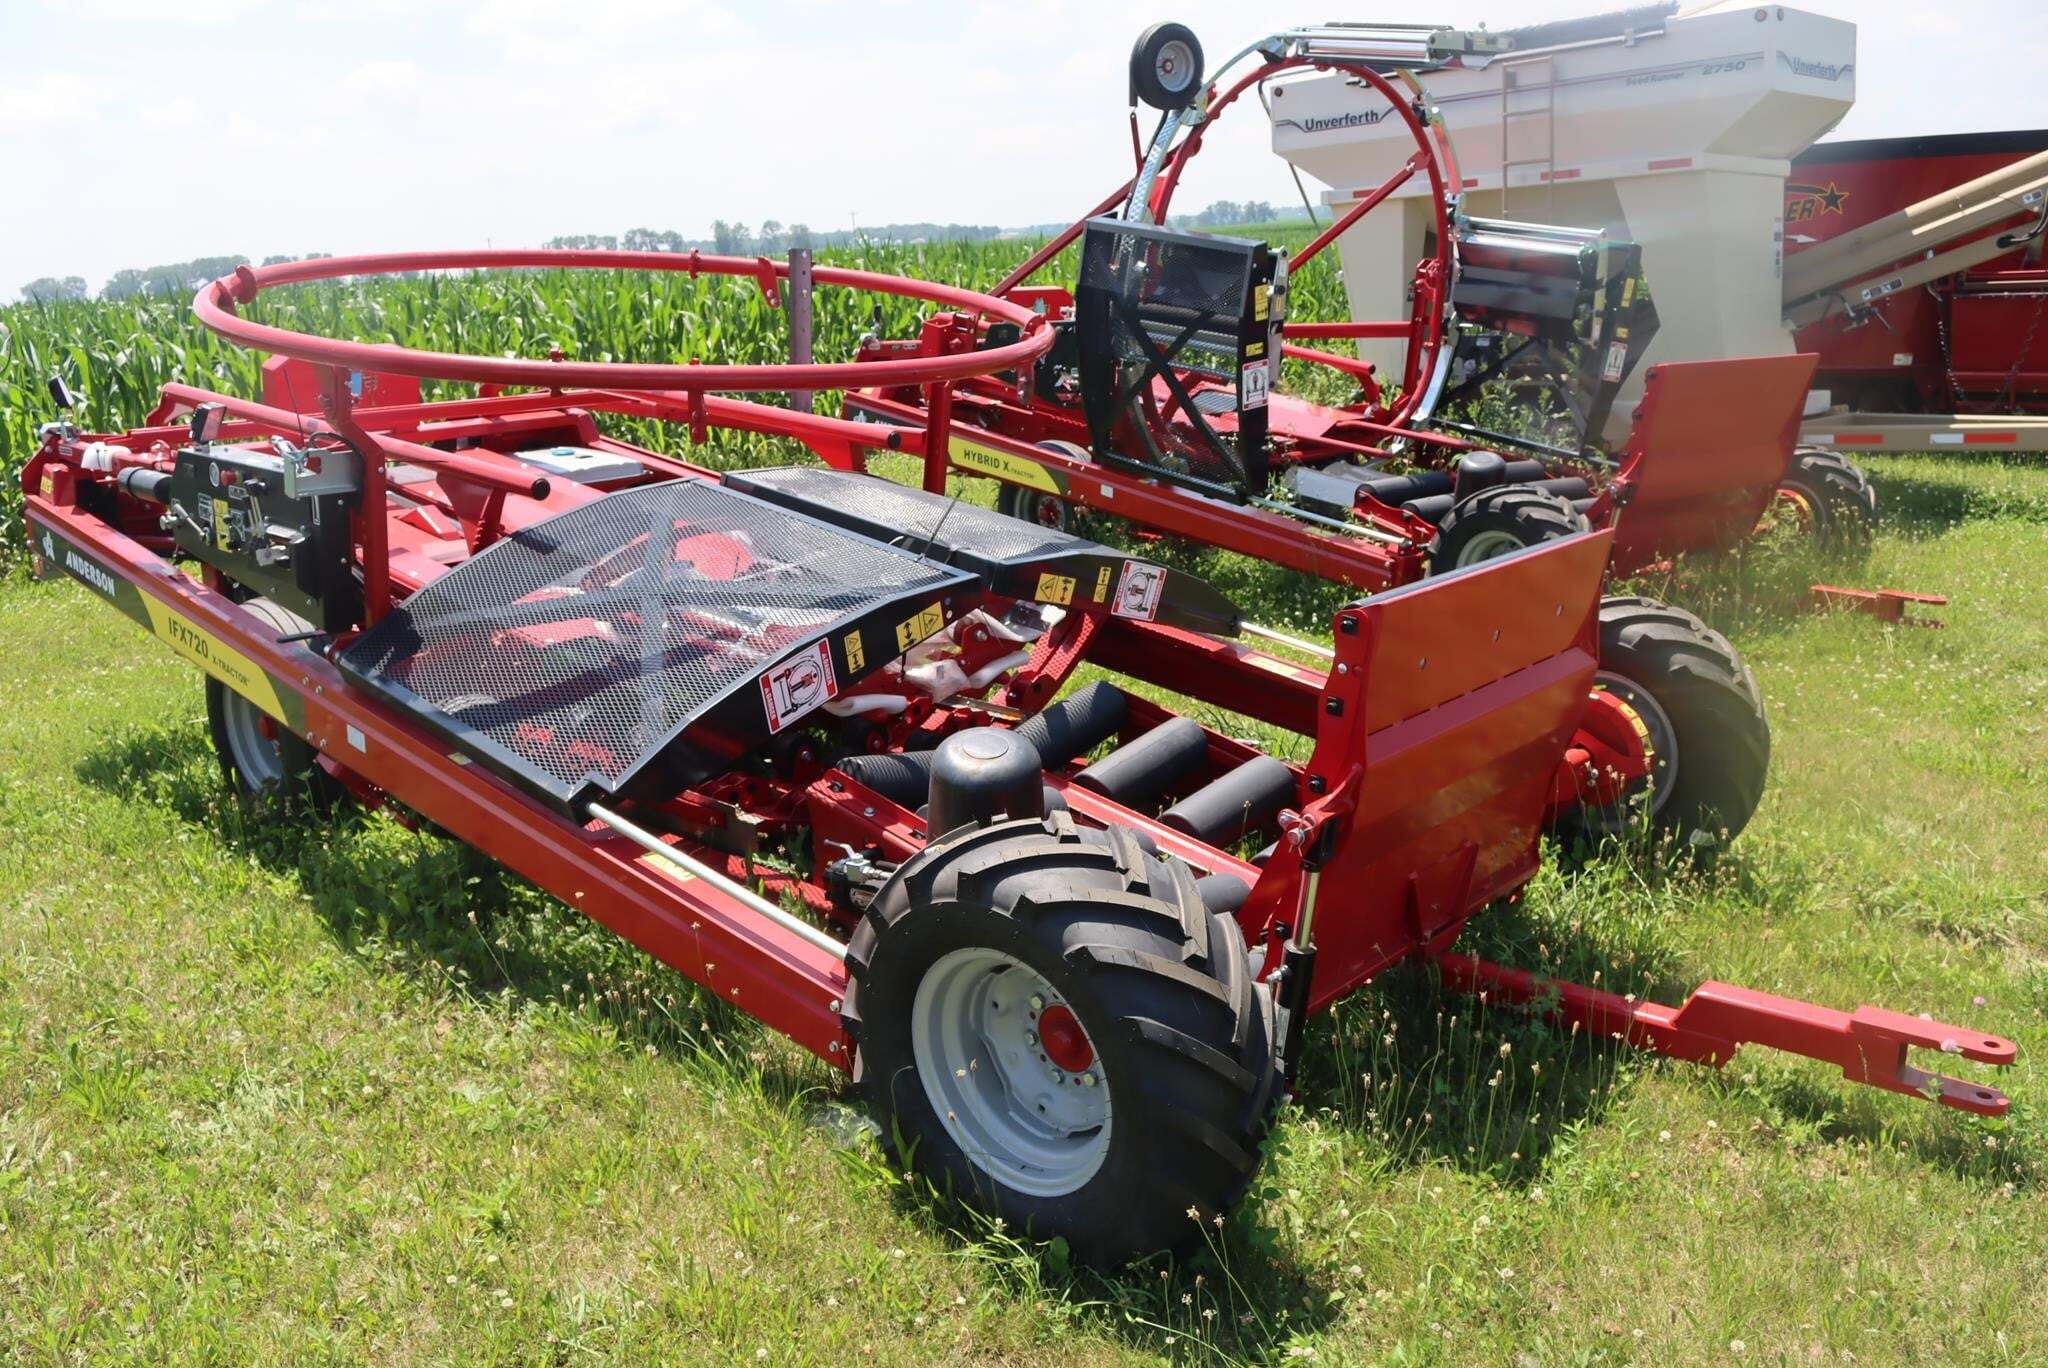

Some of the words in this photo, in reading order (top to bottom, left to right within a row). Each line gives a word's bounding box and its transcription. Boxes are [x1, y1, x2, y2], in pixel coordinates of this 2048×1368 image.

[1304, 110, 1379, 131] Unverferth
[964, 450, 1000, 468] HYBRID
[66, 551, 115, 596] ANDERSON
[168, 616, 209, 659] IFX720
